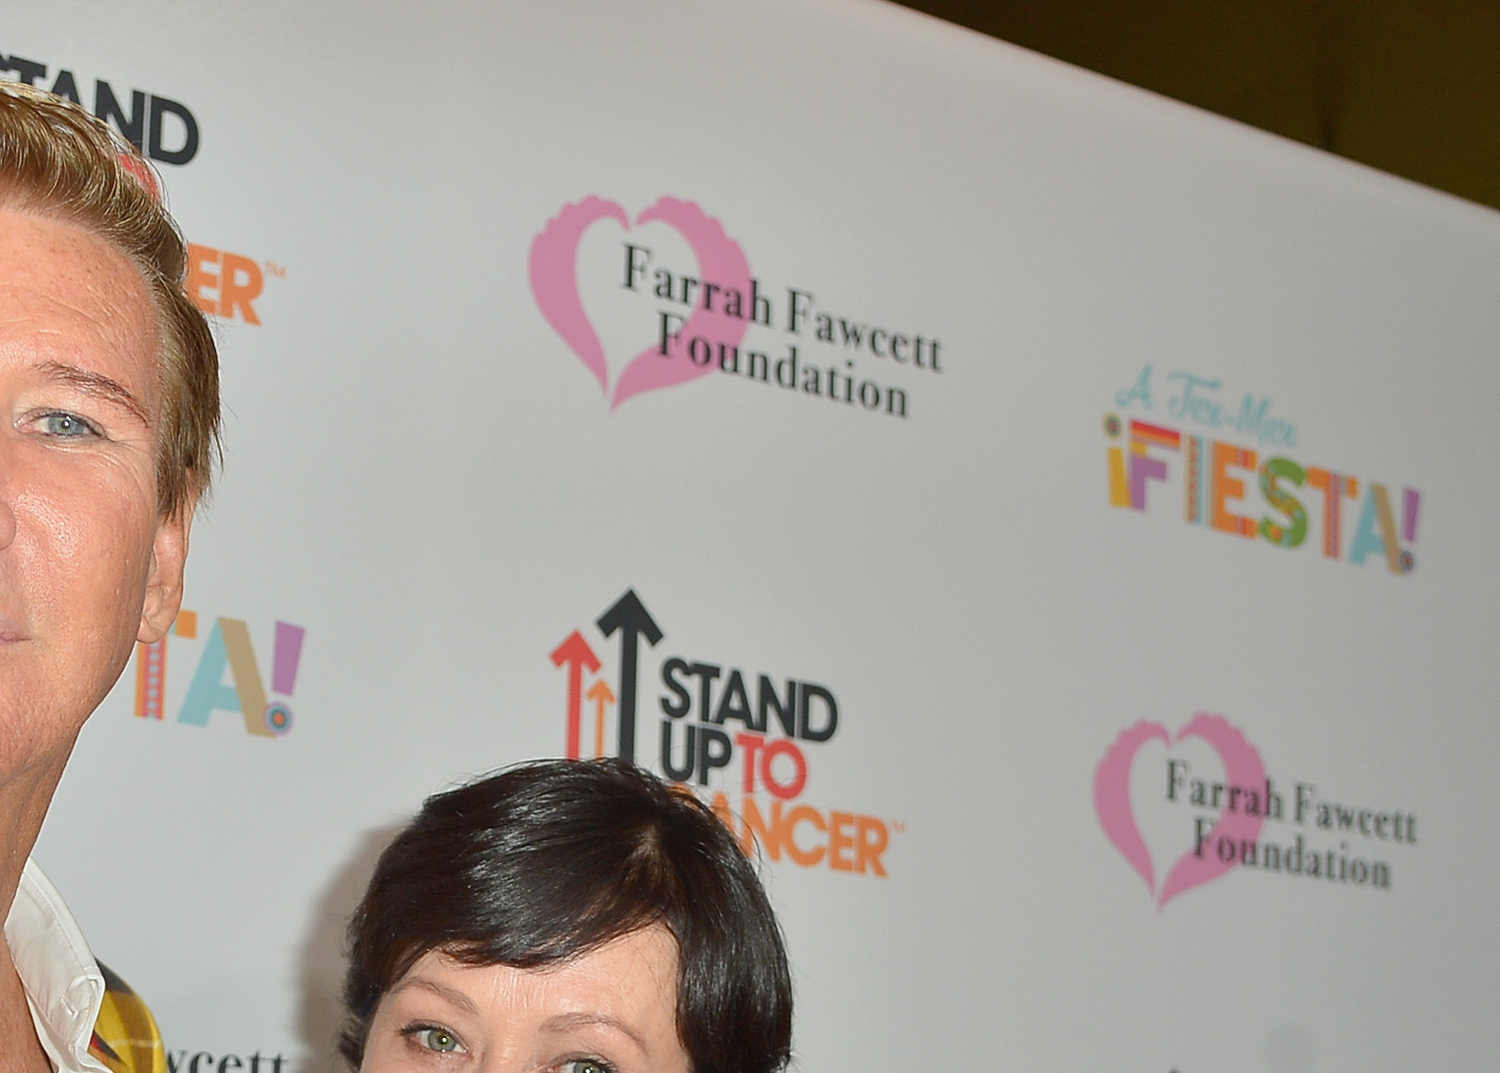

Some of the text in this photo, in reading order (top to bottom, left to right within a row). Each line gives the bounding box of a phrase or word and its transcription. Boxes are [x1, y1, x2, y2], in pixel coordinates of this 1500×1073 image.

[622, 242, 944, 373] Farrah Fawcett
[656, 308, 910, 419] Foundation
[660, 657, 838, 742] STAND
[661, 719, 809, 800] UP TO
[1166, 758, 1418, 845] Farrah Fawcett
[1194, 818, 1390, 888] Foundation
